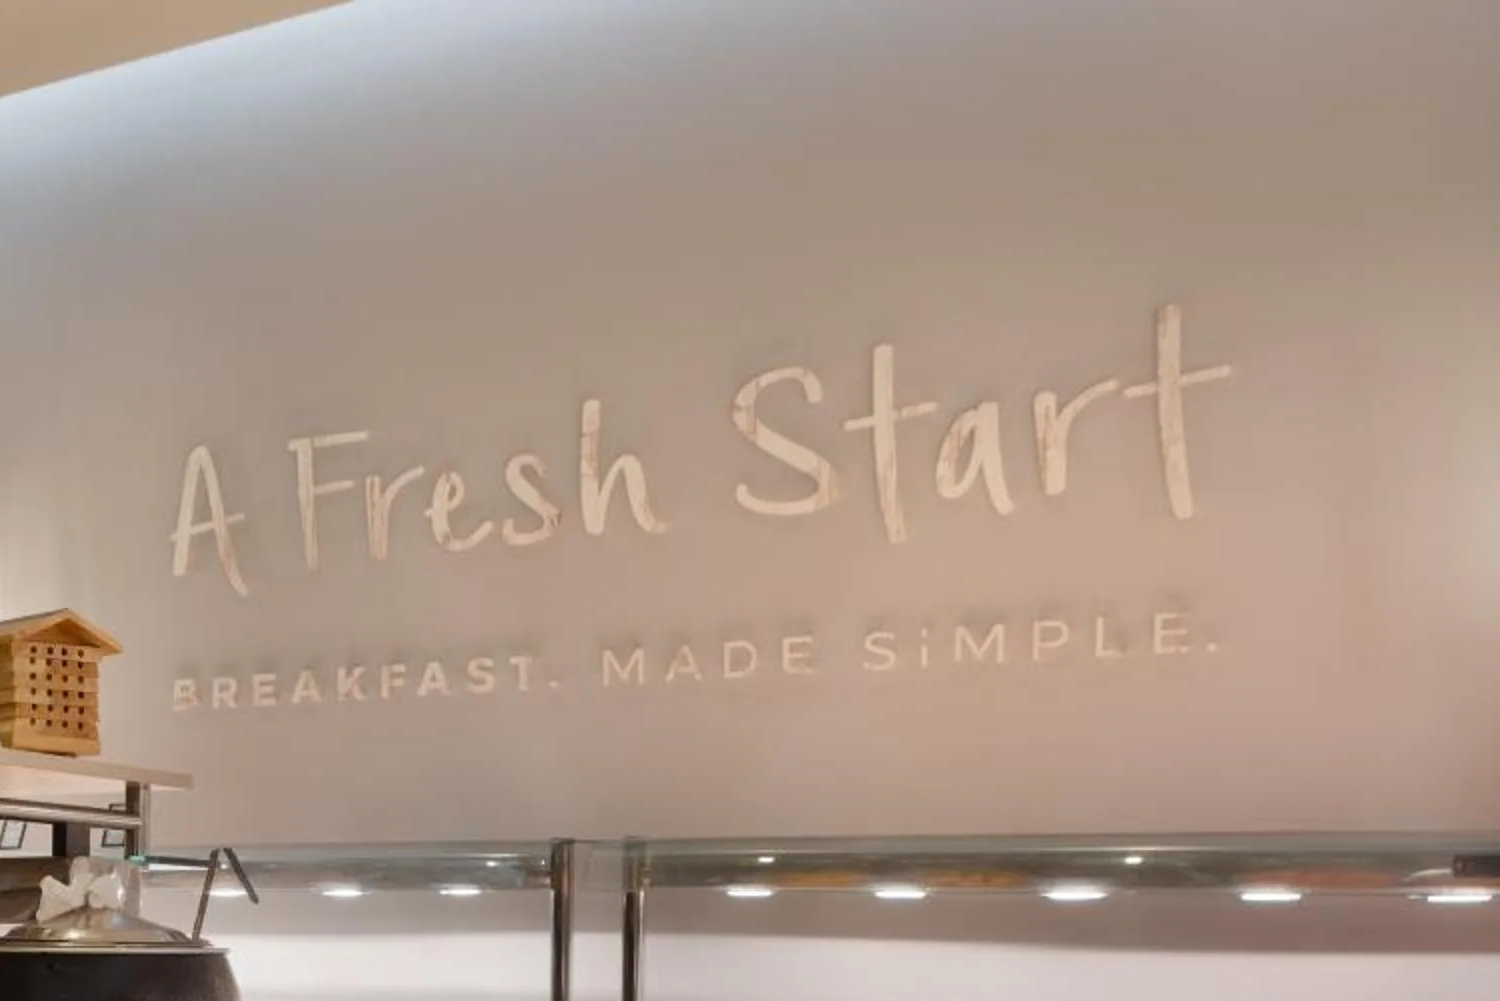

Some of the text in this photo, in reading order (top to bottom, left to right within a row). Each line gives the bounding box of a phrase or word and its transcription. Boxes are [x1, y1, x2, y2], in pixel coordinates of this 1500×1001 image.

[170, 303, 1232, 596] A Fresh Start
[172, 655, 560, 712] BREAKFAST.
[601, 635, 815, 687] MADE
